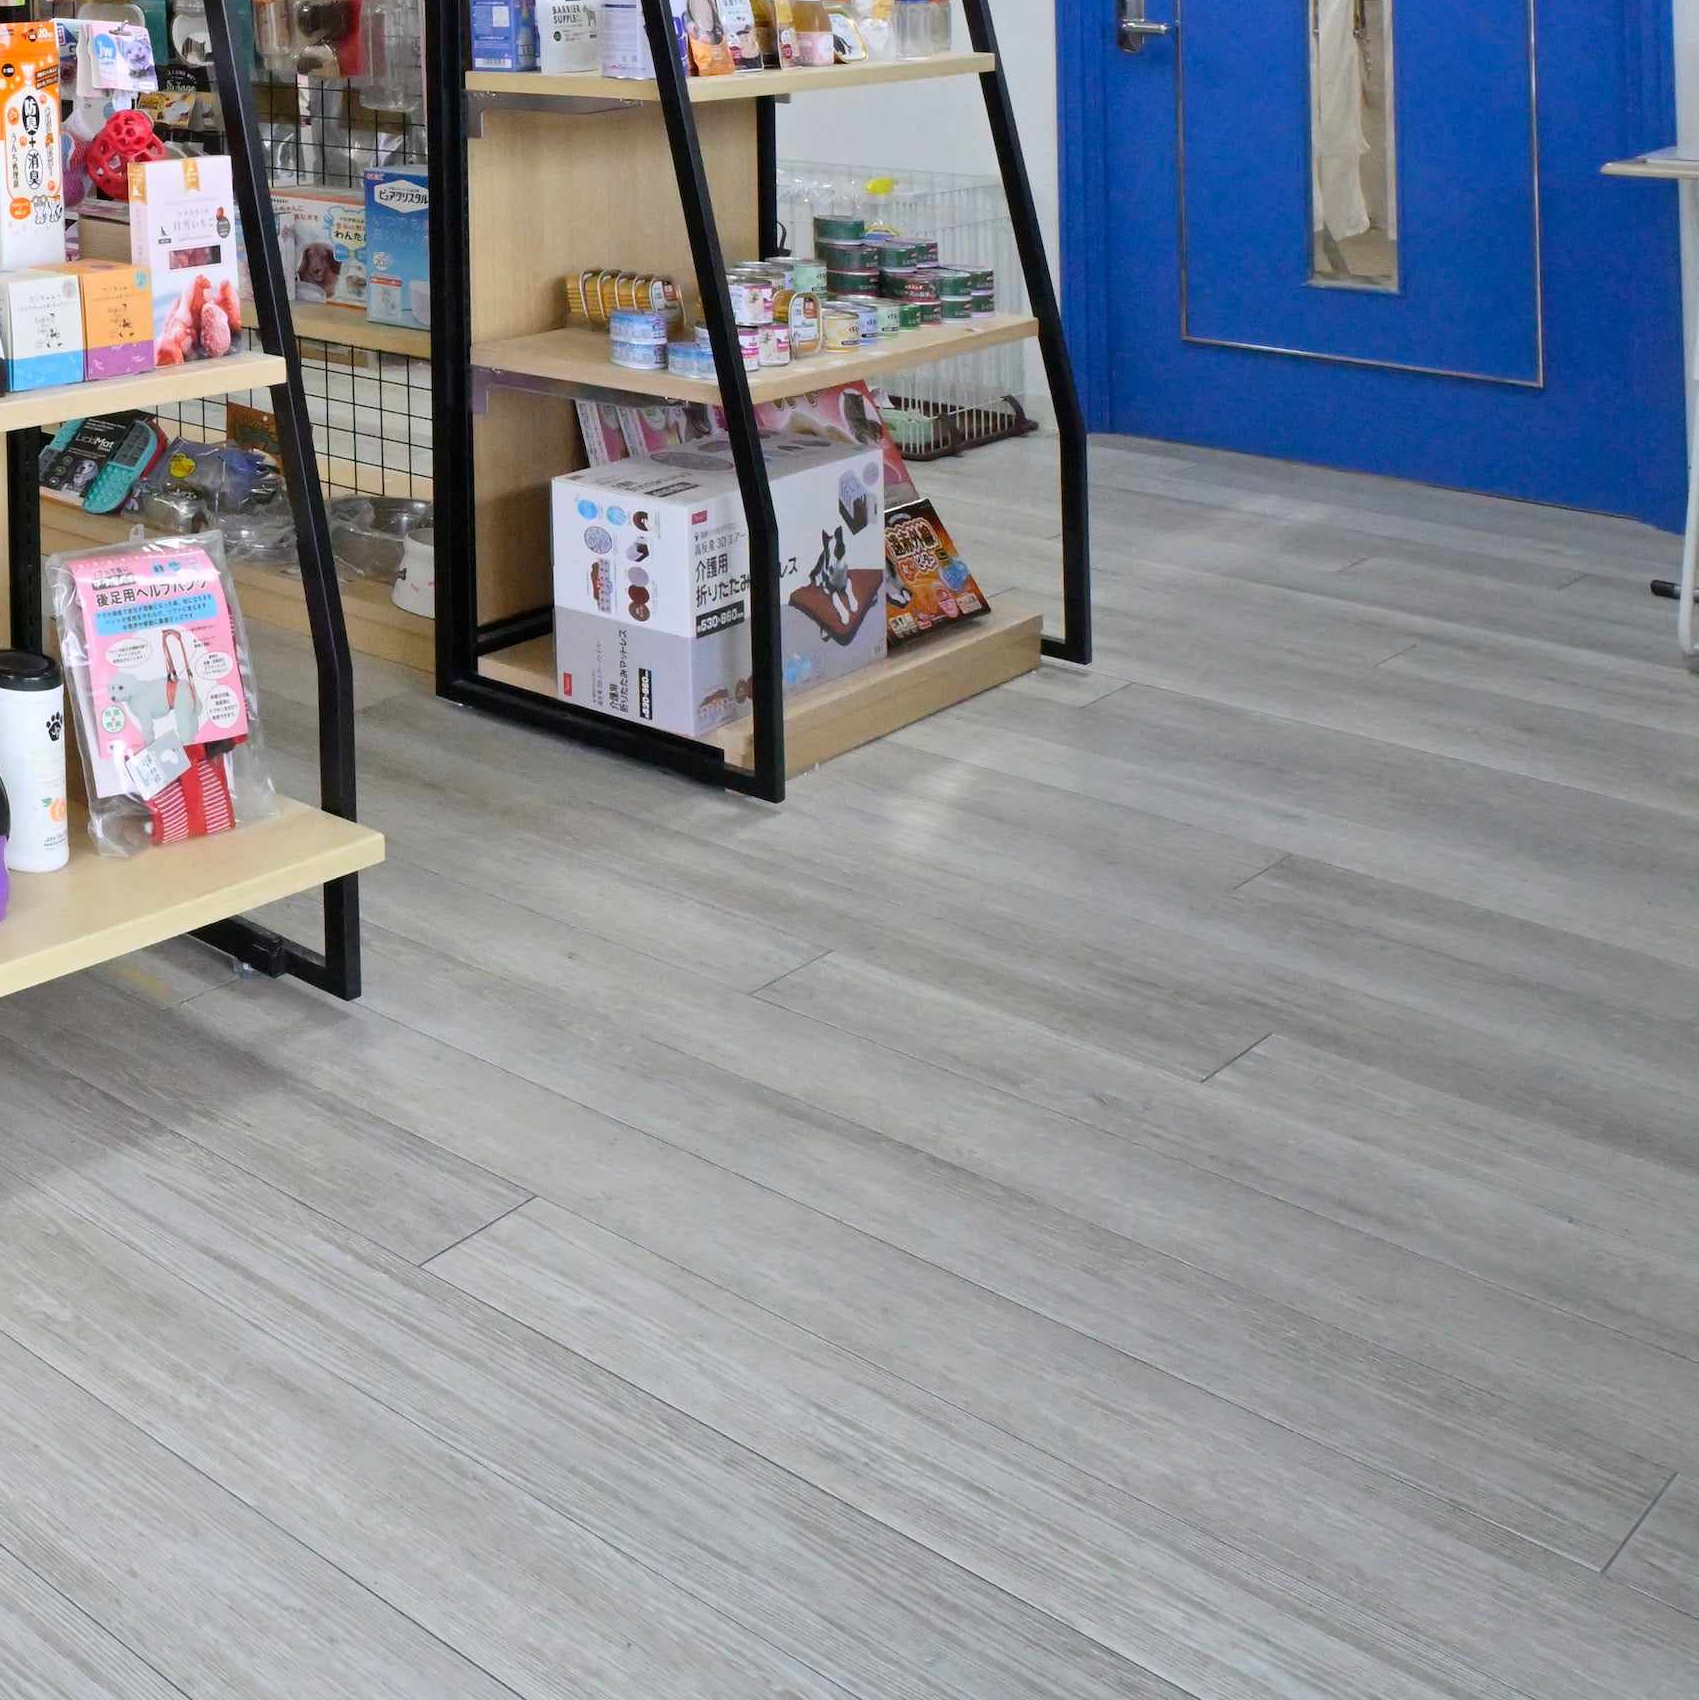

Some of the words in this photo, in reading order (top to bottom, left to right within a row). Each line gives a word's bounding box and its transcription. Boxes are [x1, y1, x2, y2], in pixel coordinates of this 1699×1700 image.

[552, 4, 581, 14] BARRIER
[24, 97, 38, 132] 防臭
[27, 152, 40, 187] 消臭
[379, 189, 428, 205] ピュアクリスタル
[695, 552, 729, 583] 介護用
